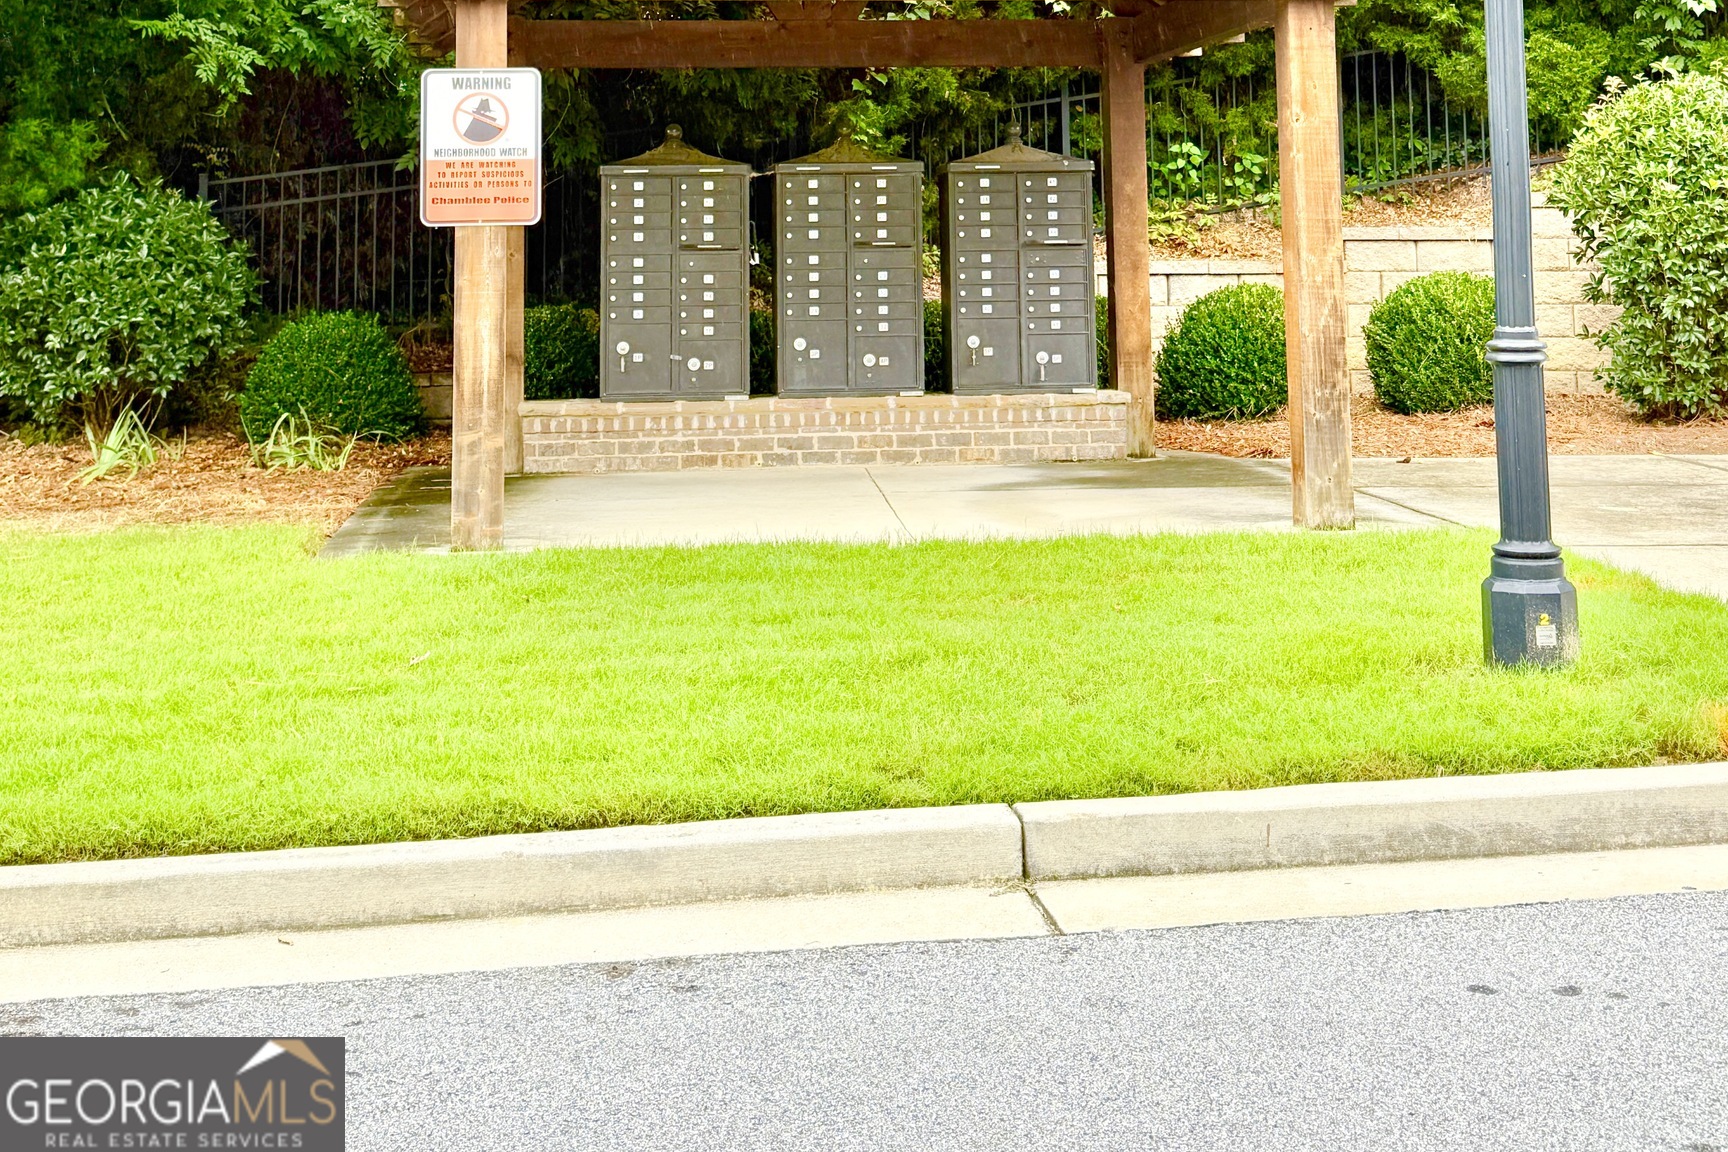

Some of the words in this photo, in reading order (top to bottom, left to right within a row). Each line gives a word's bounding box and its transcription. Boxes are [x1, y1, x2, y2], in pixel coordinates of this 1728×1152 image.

[451, 76, 512, 91] WARNING
[433, 148, 496, 158] NEIGHBORHOOD
[499, 147, 528, 157] WATCH
[445, 161, 456, 169] WE
[460, 161, 474, 169] ARE
[437, 171, 447, 179] TO
[450, 171, 477, 179] REPORT
[481, 170, 525, 178] SUSPICIOUS
[428, 181, 469, 189] ACTIVITIES
[473, 180, 483, 188] OR
[487, 180, 519, 188] PERSONS
[523, 180, 532, 188] TO
[431, 196, 491, 205] Chamblee
[493, 195, 530, 204] Police
[1539, 613, 1550, 626] 2
